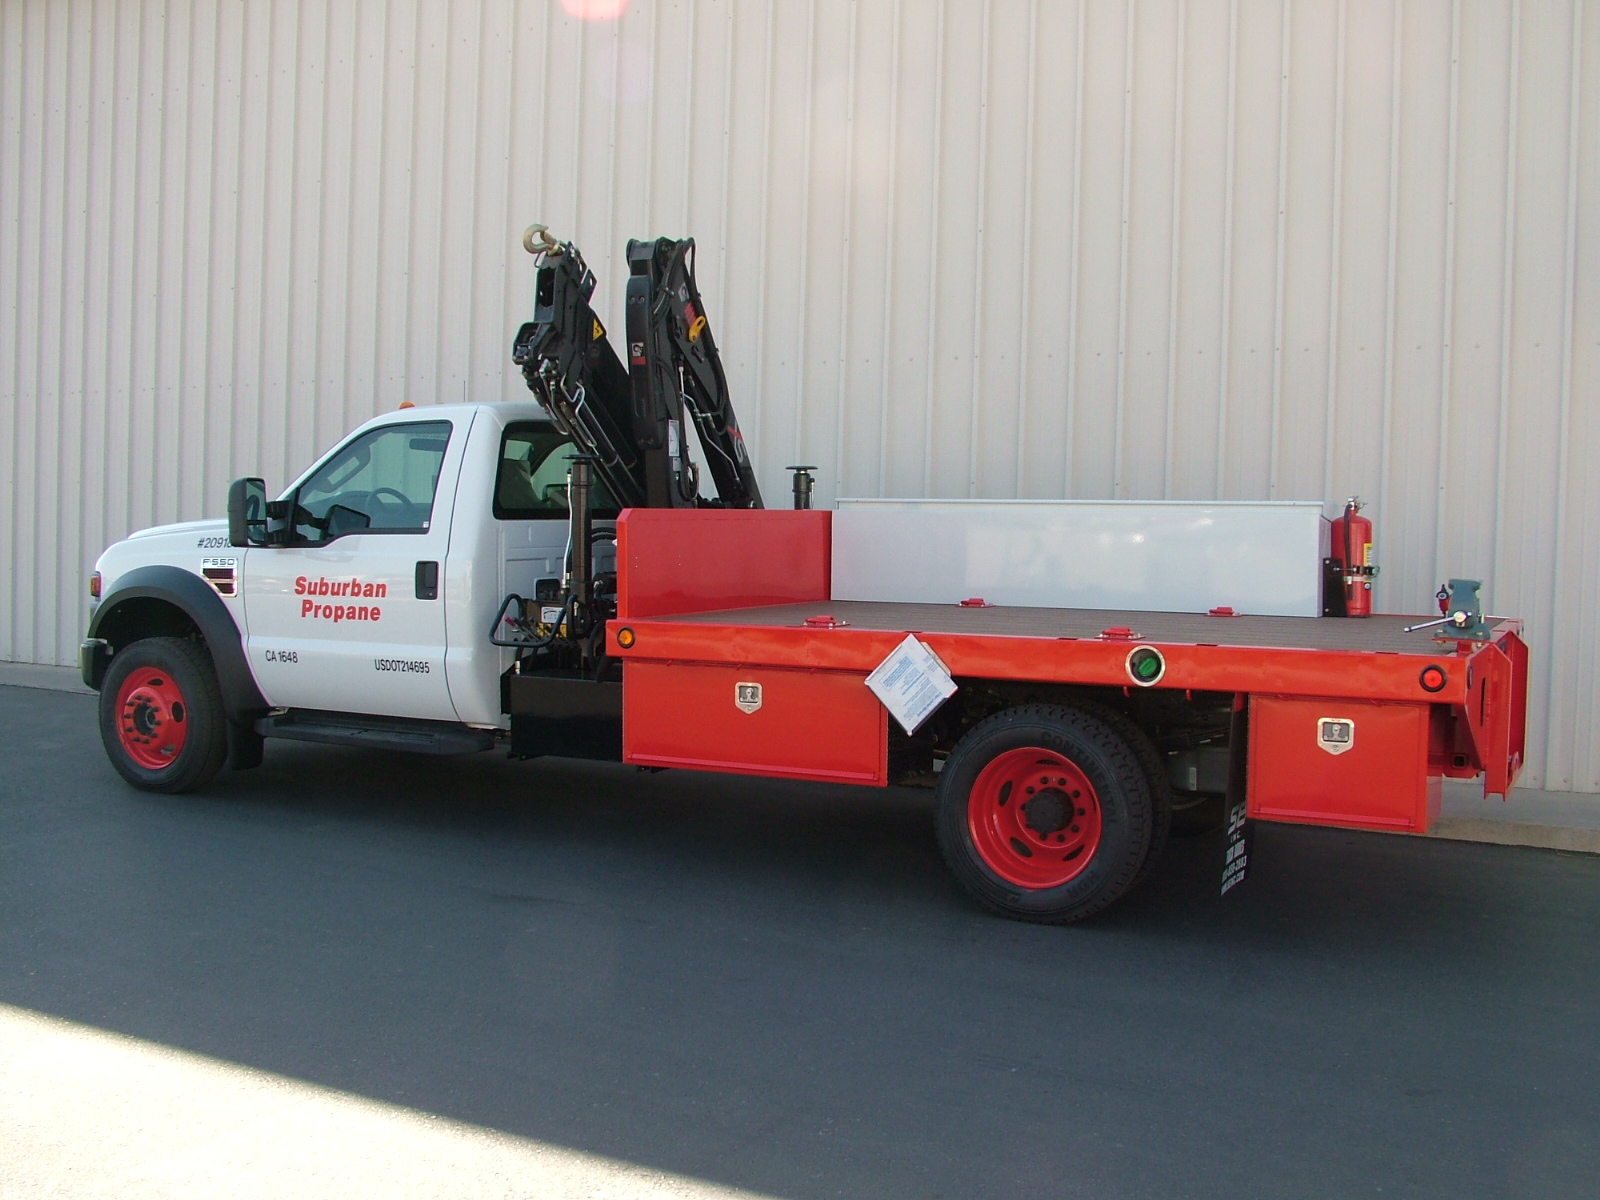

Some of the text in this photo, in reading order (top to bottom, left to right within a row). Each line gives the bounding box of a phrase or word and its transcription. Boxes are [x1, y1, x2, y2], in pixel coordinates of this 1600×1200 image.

[294, 576, 387, 598] Suburban
[301, 599, 381, 622] Propane
[265, 650, 298, 664] CA 1648
[374, 659, 430, 673] USDOT214695
[1041, 731, 1117, 825] CONTINENTAL
